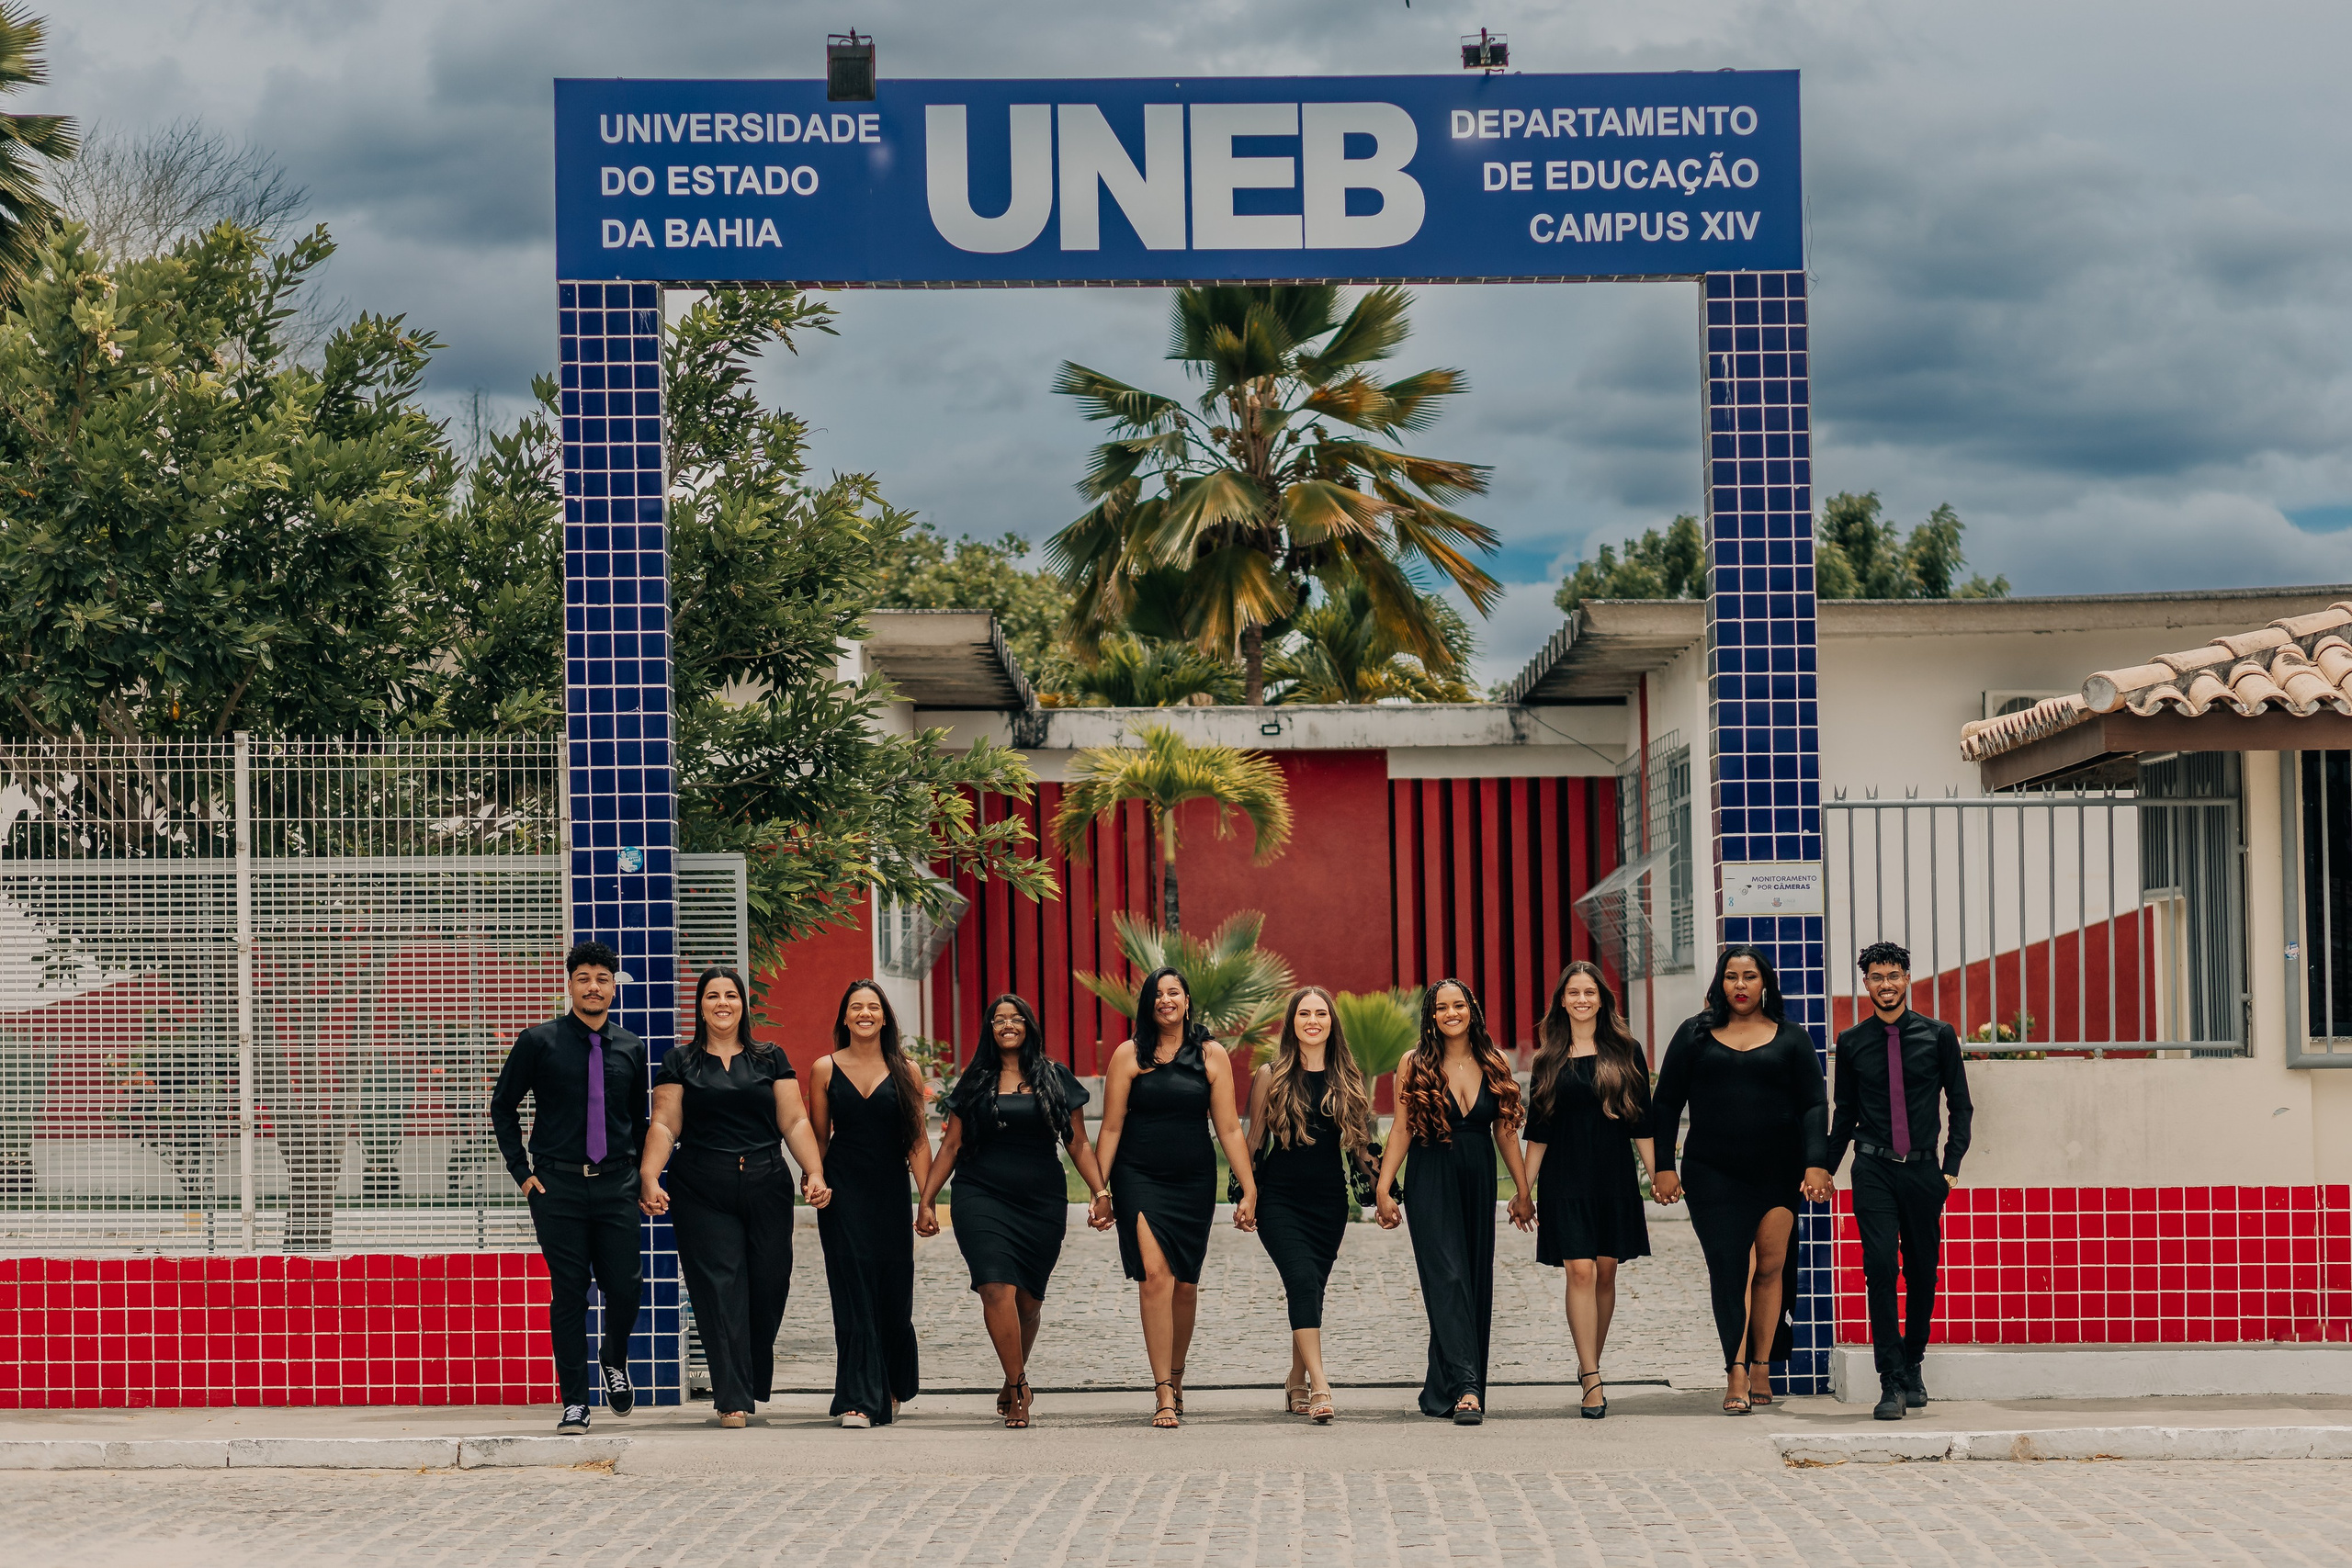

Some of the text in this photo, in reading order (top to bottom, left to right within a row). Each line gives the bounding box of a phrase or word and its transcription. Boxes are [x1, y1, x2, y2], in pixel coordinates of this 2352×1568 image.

[600, 113, 881, 143] UNIVERSIDADE
[1451, 106, 1758, 140] DEPARTAMENTO
[601, 165, 820, 196] DO ESTADO
[925, 102, 1426, 254] UNEB
[1483, 152, 1759, 196] DE EDUCAÇÃO
[602, 218, 783, 248] DA BAHIA
[1530, 211, 1761, 243] CAMPUS XIV
